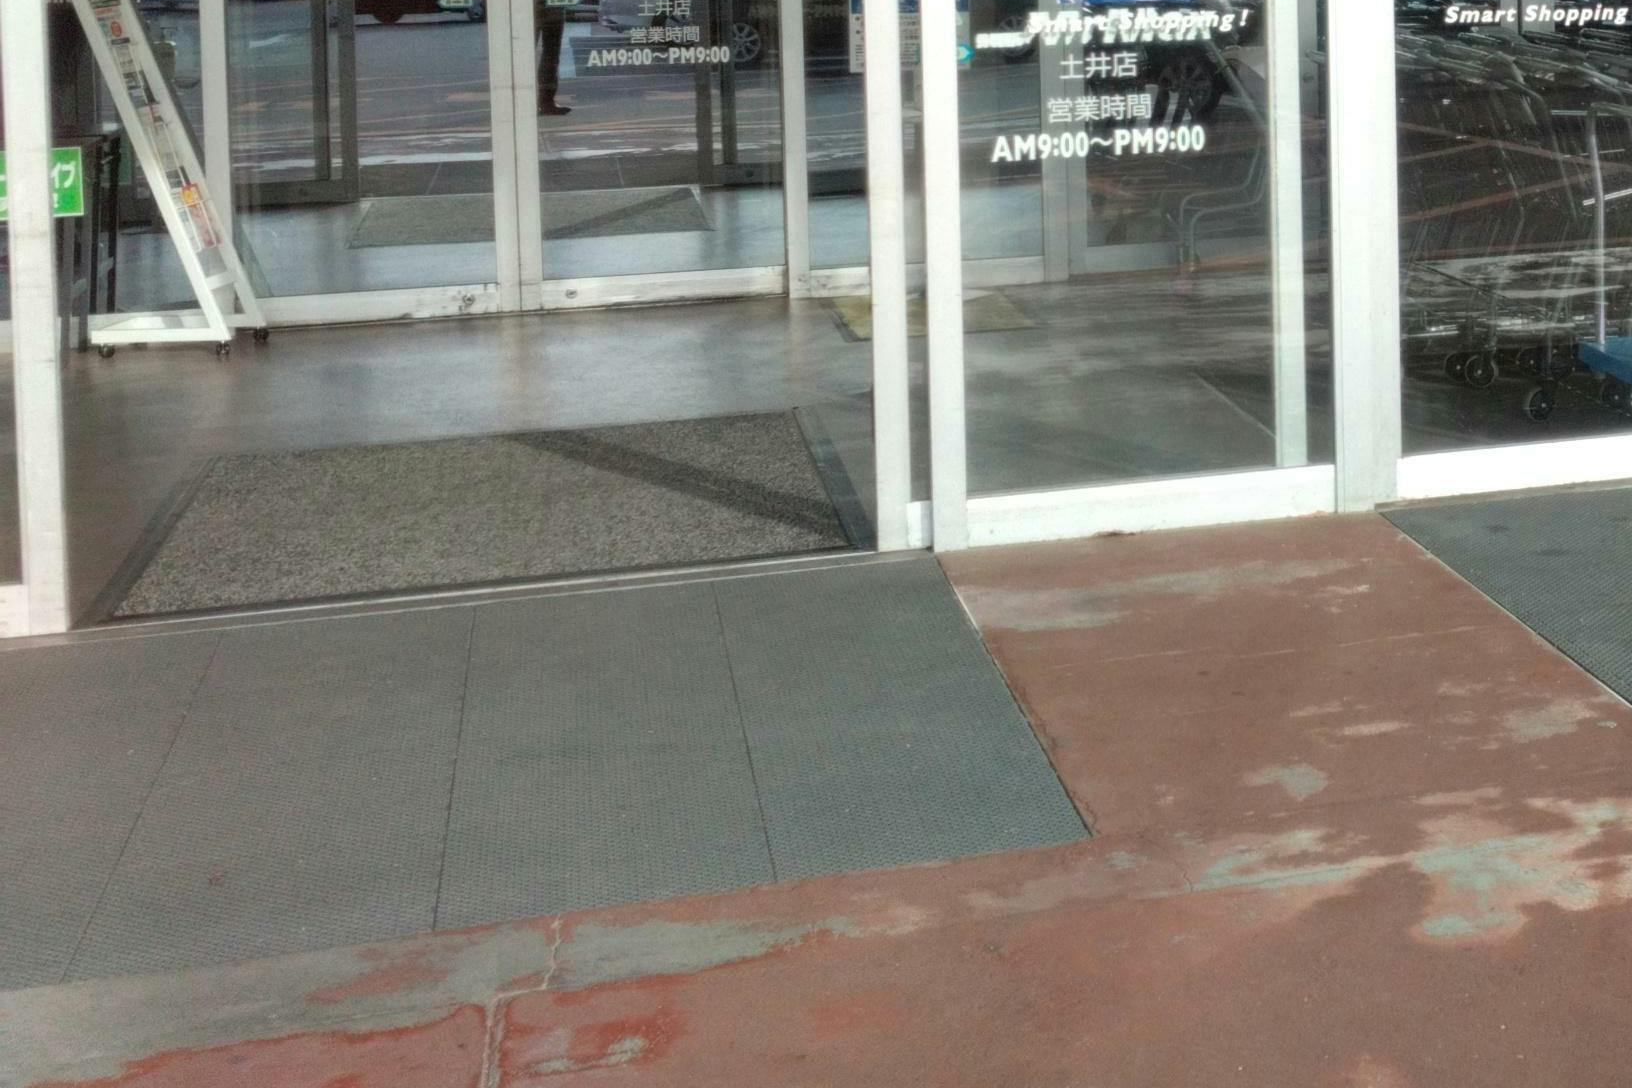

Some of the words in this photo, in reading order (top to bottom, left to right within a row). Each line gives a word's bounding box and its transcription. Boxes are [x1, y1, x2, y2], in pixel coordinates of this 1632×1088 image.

[638, 0, 691, 17] 土井店
[1444, 6, 1517, 25] Smart
[630, 26, 701, 43] 営業時間
[1059, 52, 1138, 80] 土井店
[1047, 94, 1152, 124] 営業時間
